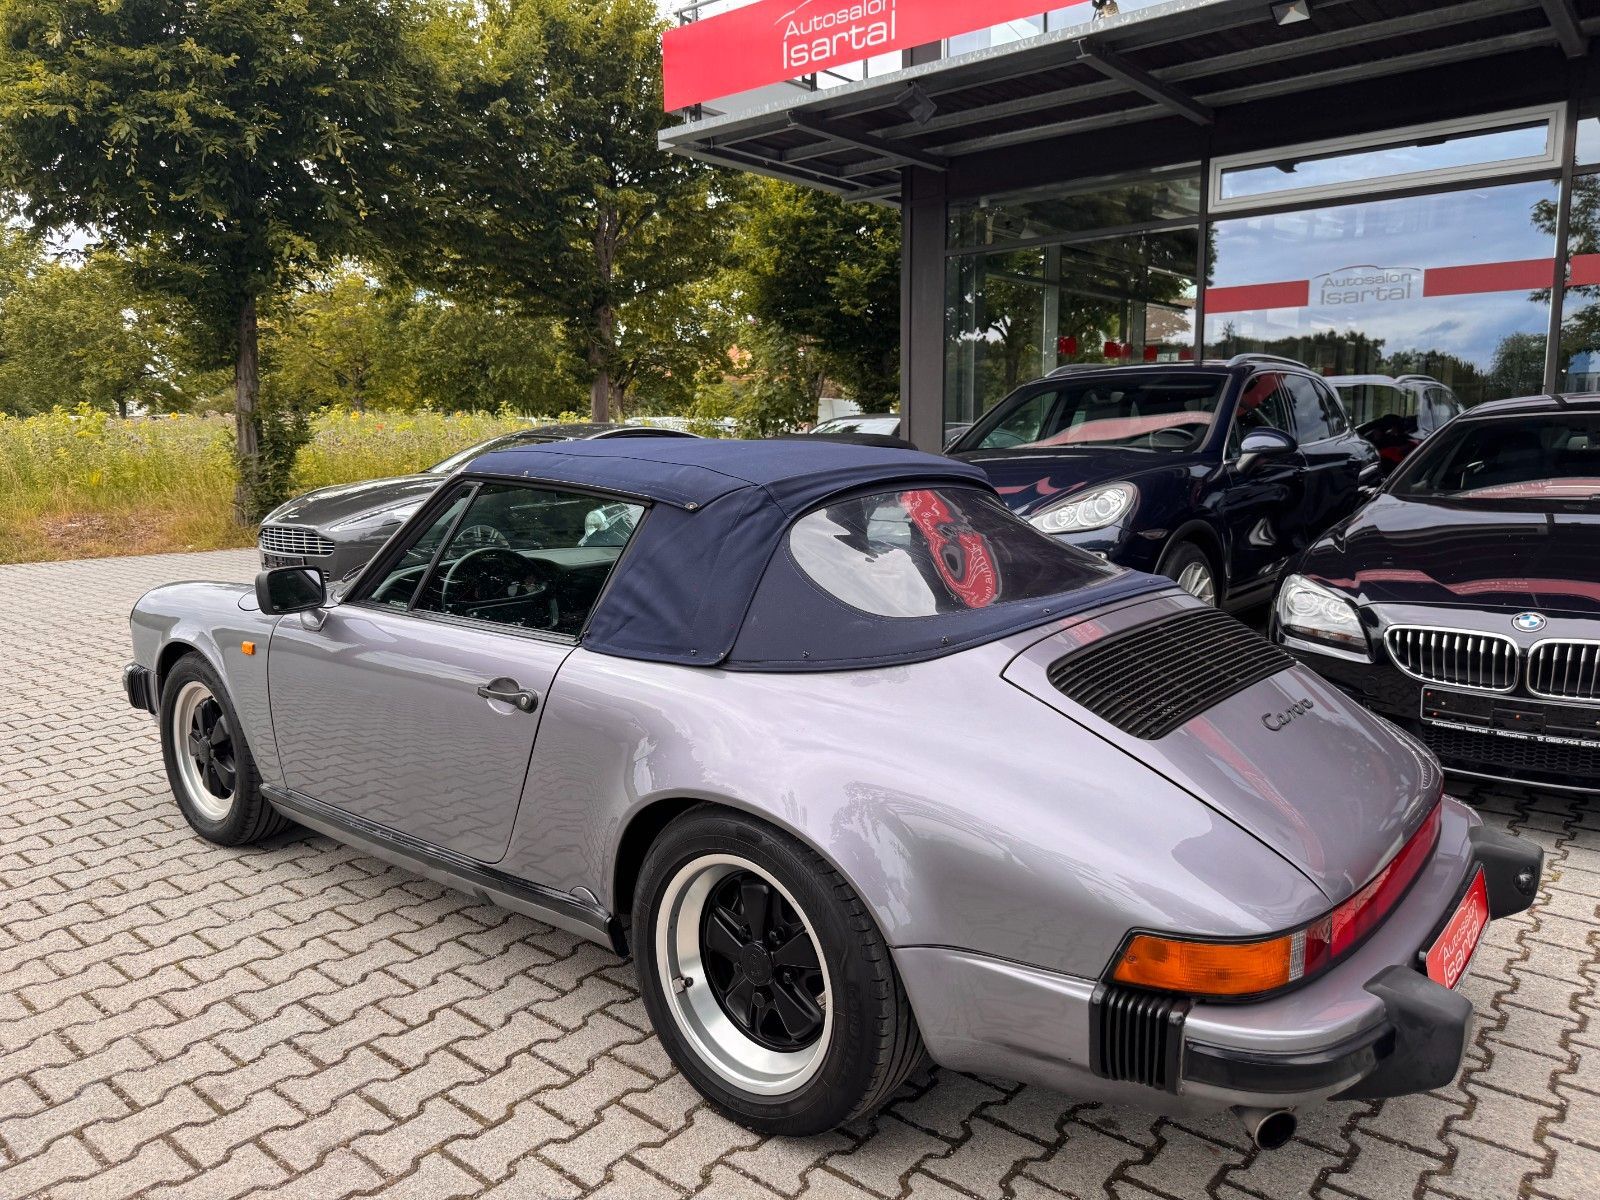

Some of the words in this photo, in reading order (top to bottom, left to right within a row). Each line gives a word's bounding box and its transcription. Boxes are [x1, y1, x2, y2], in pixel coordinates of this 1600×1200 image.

[783, 9, 896, 70] Isartal
[1321, 272, 1411, 289] Autosalon
[1320, 282, 1411, 306] Isartal
[1432, 720, 1465, 730] Autosalon
[1443, 909, 1480, 989] Isartal
